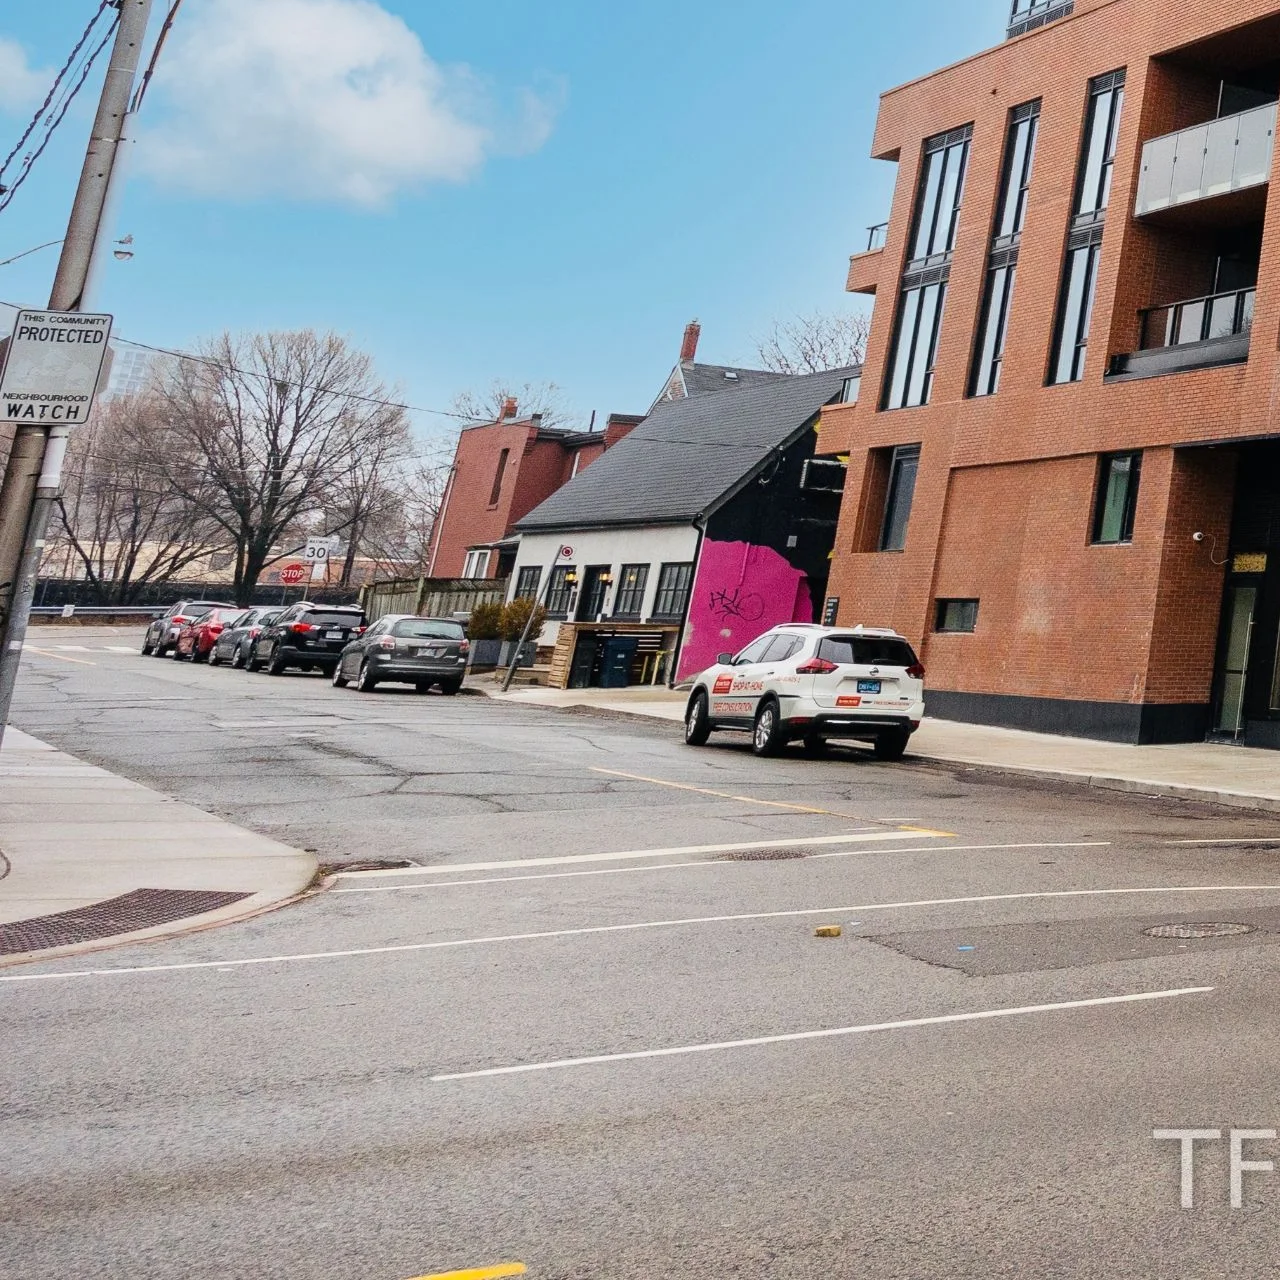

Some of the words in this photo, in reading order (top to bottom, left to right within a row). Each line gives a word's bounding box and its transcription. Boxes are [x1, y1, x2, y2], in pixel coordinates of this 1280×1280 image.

[23, 314, 45, 322] THIS
[49, 316, 108, 325] COMMUNITY
[17, 326, 104, 344] PROTECTED
[2, 392, 89, 402] NEIGHBOURHOOD
[7, 403, 80, 419] WATCH
[306, 547, 326, 559] 30
[281, 569, 305, 578] STOP
